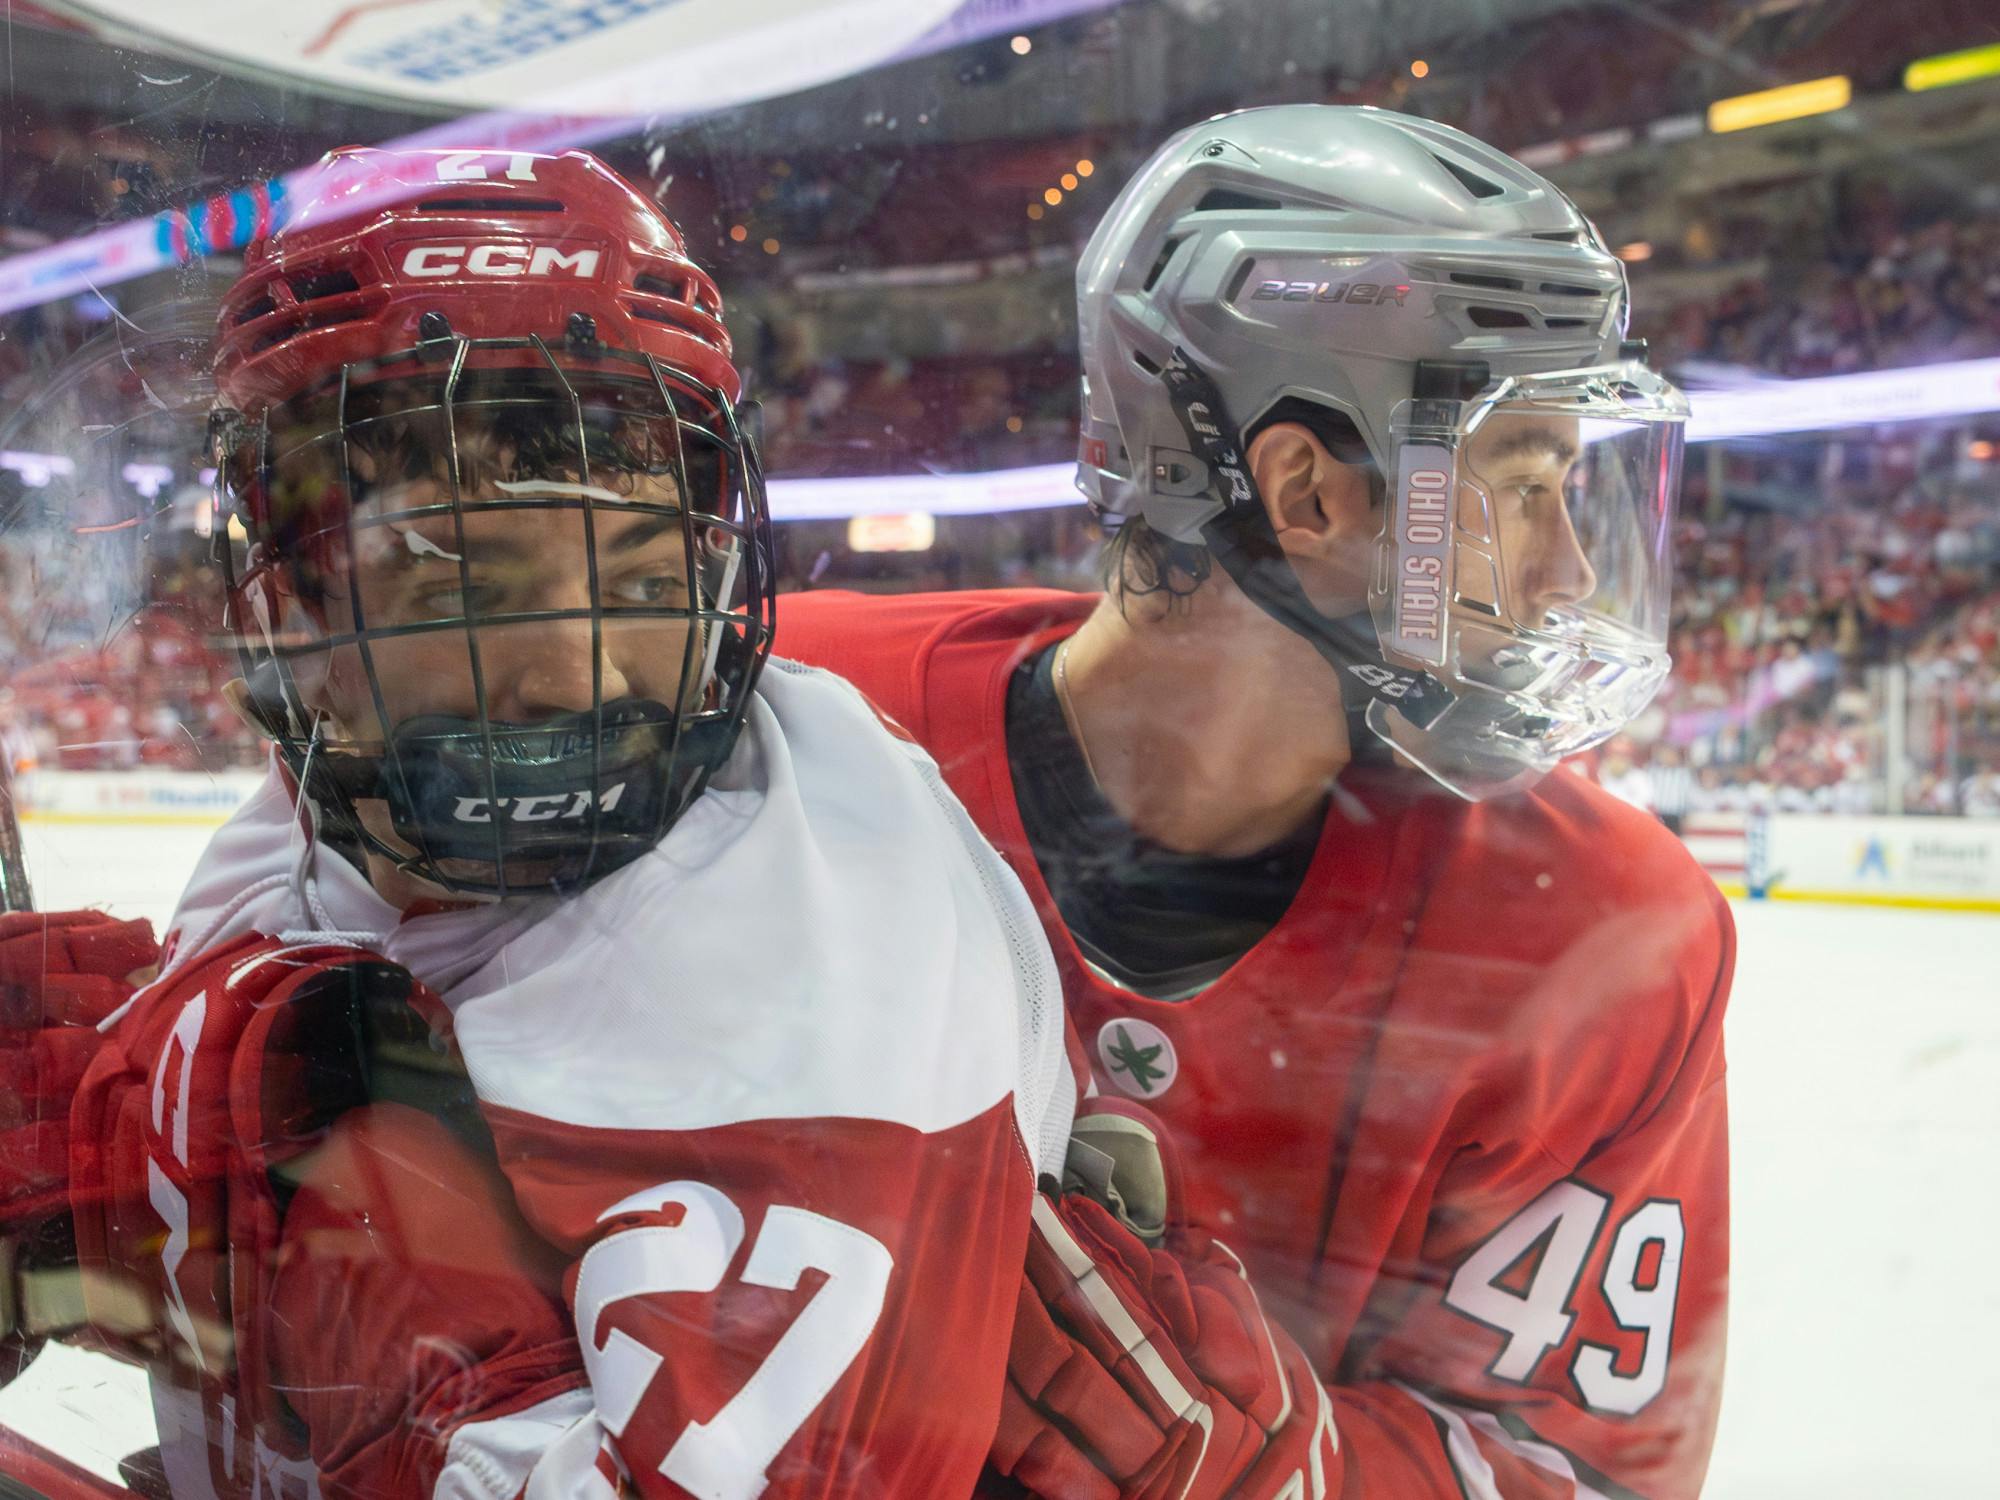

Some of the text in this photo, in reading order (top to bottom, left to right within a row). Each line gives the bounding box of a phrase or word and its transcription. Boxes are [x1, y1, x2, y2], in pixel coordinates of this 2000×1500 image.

[402, 245, 600, 278] CCM
[1251, 280, 1411, 307] BAUER
[1401, 470, 1448, 640] OHIO STATE
[453, 782, 626, 822] CCM
[574, 1180, 894, 1500] 27
[1440, 1175, 1686, 1419] 49
